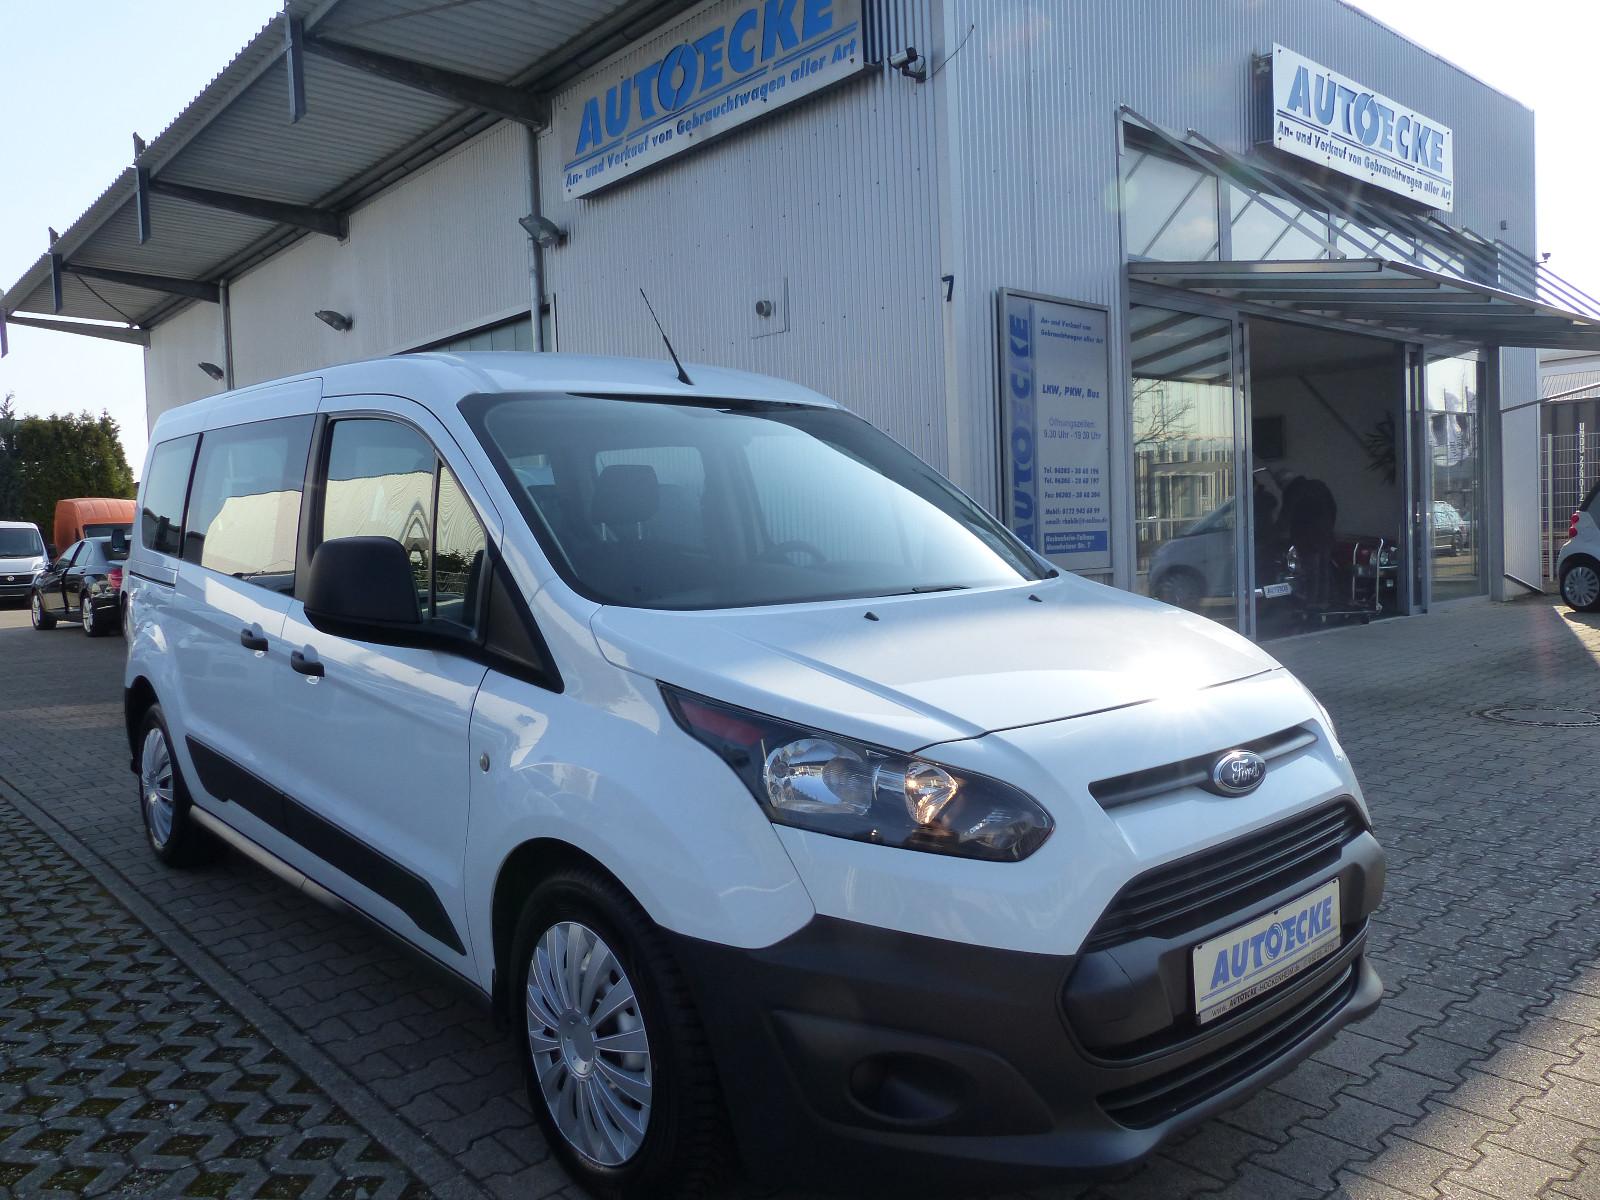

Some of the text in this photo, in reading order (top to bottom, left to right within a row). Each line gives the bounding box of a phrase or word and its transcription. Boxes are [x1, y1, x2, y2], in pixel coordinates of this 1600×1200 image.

[565, 39, 856, 188] An- und Verkauf von Gebrauchtwagen aller Art
[575, 0, 833, 155] AUTOECKE
[1286, 64, 1444, 173] AUTOECKE
[1277, 120, 1294, 137] An-
[1295, 130, 1312, 146] und
[1314, 134, 1347, 160] Verkauf
[1348, 152, 1362, 166] von
[1364, 155, 1423, 190] Gebrauchtwagen
[1424, 178, 1440, 197] aller
[942, 275, 954, 302] 7
[1231, 758, 1260, 784] Ford
[1209, 895, 1333, 990] AUTOECKE
